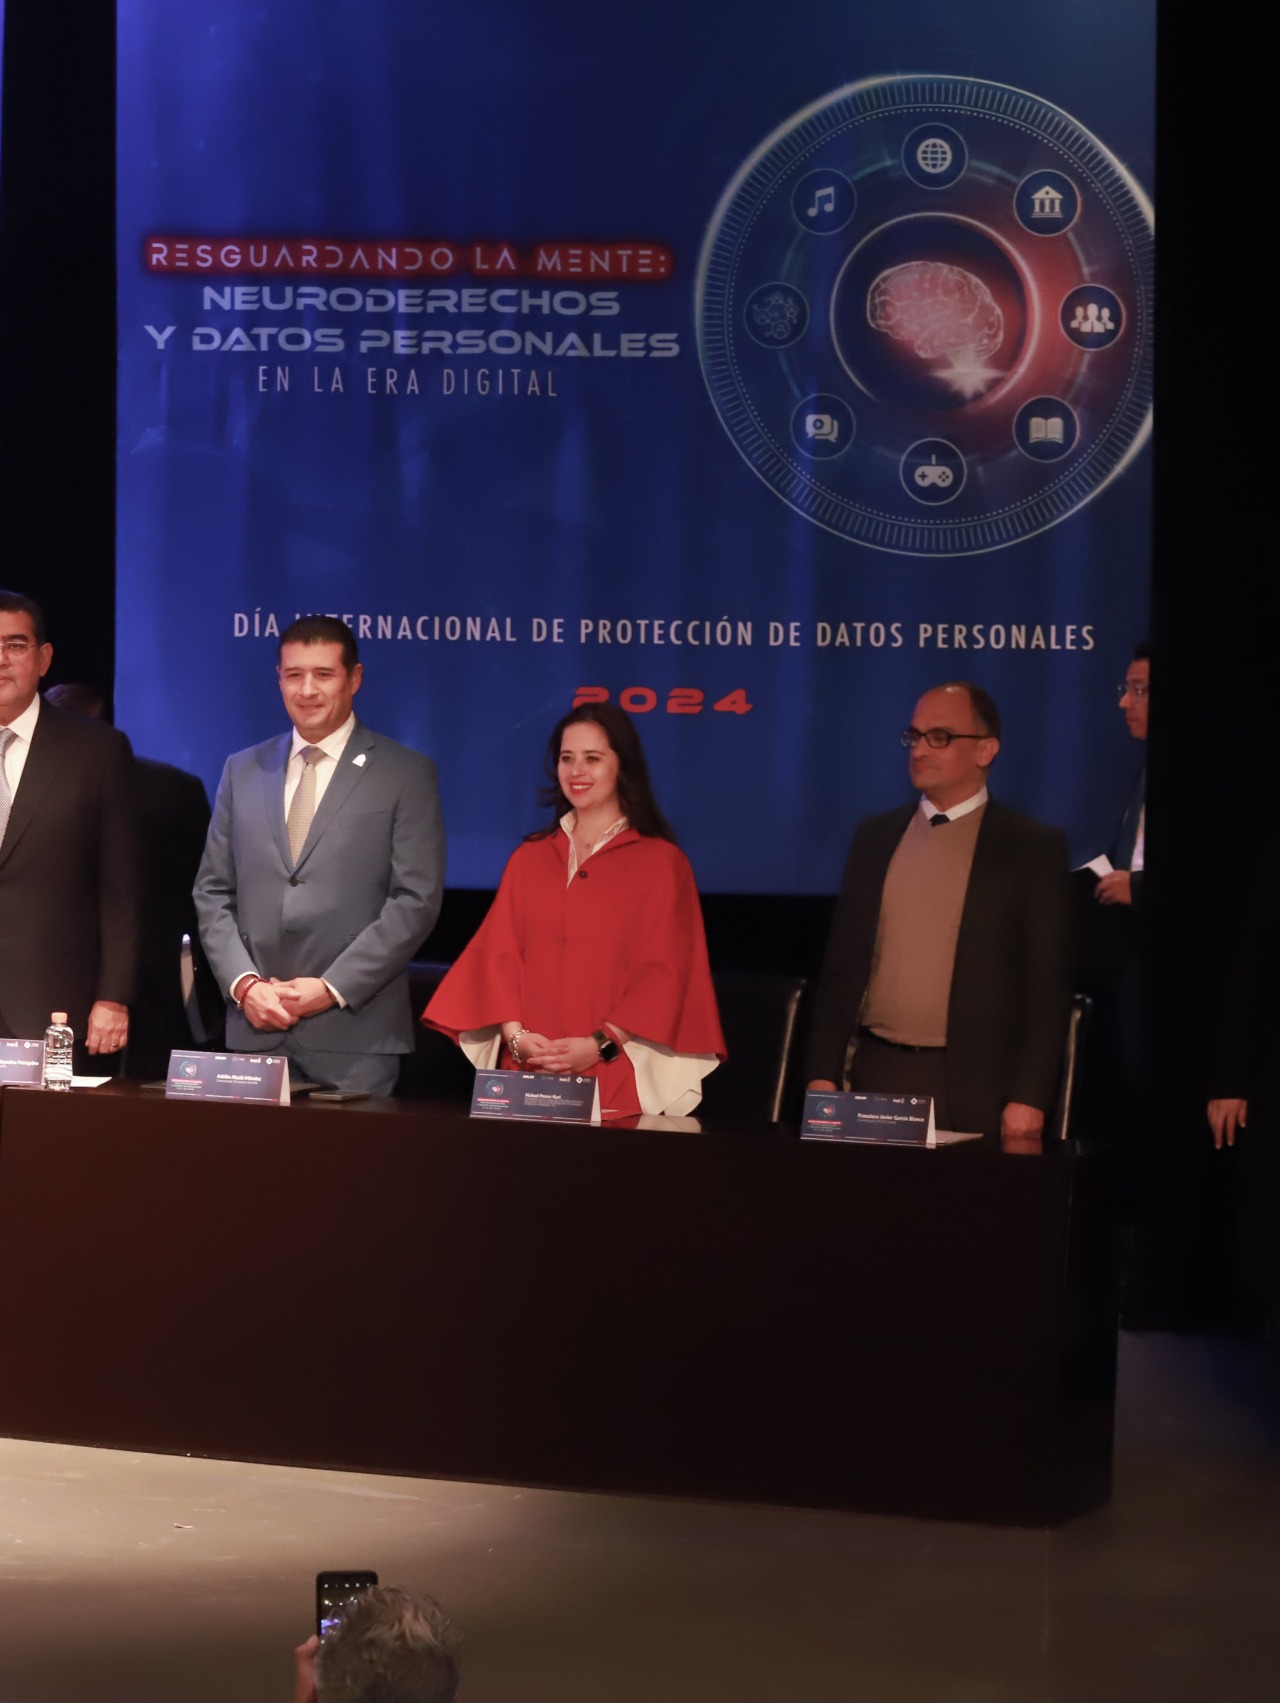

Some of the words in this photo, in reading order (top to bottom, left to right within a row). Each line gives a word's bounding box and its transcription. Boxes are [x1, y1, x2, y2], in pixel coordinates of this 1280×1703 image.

[151, 242, 454, 270] RESGUARDANDO
[475, 246, 516, 270] LA
[537, 248, 666, 273] MENTE:
[203, 285, 621, 316] NEURODERECHOS
[143, 325, 177, 351] Y
[192, 327, 345, 352] DATOS
[359, 329, 680, 358] PERSONALES
[258, 365, 289, 392] EN
[314, 366, 344, 393] LA
[367, 367, 419, 395] ERA
[443, 368, 558, 397] DIGITAL
[234, 607, 280, 638] DÍA
[532, 617, 565, 643] DE
[580, 614, 752, 646] PROTECCIÓN
[769, 621, 801, 647] DE
[816, 622, 903, 648] DATOS
[919, 623, 1094, 651] PERSONALES
